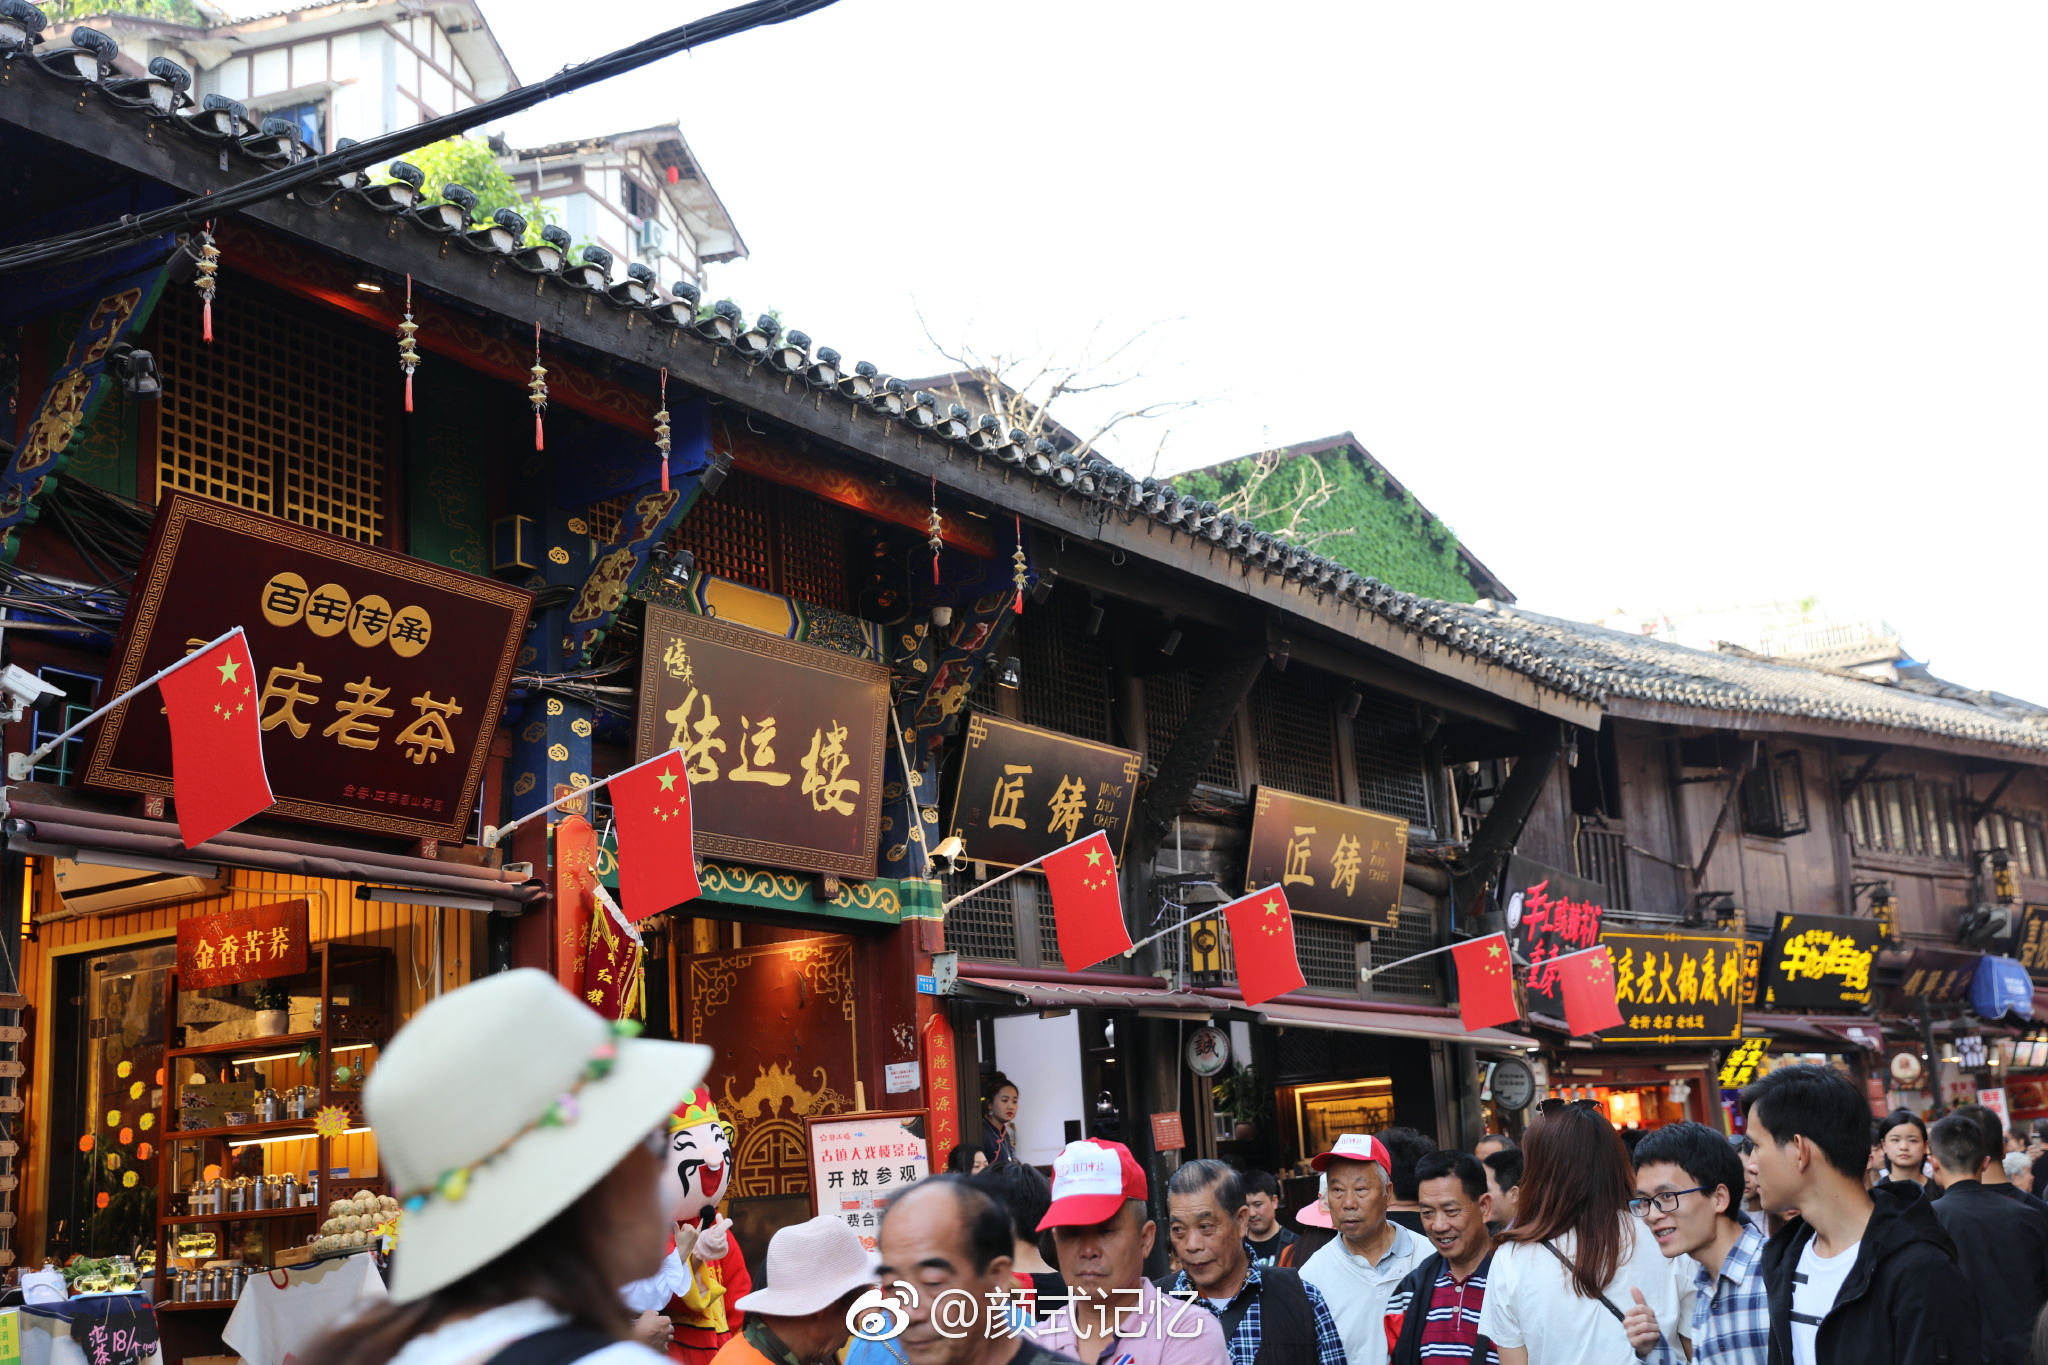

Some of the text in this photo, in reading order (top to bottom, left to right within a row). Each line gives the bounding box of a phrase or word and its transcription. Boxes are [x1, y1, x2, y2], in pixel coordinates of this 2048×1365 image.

[266, 580, 429, 646] 百年传承
[146, 797, 164, 817] 福
[988, 764, 1088, 843] 匠铸
[1095, 798, 1115, 814] ZHU
[1093, 814, 1120, 830] CRAFT
[422, 840, 437, 858] 福
[1283, 825, 1363, 897] 匠铸
[193, 927, 290, 971] 金香苦荞
[1606, 946, 1740, 1006] 庆老火锅底料
[922, 983, 934, 992] 110
[821, 1142, 919, 1162] 古镇大戏楼景点
[828, 1165, 917, 1189] 开放参观
